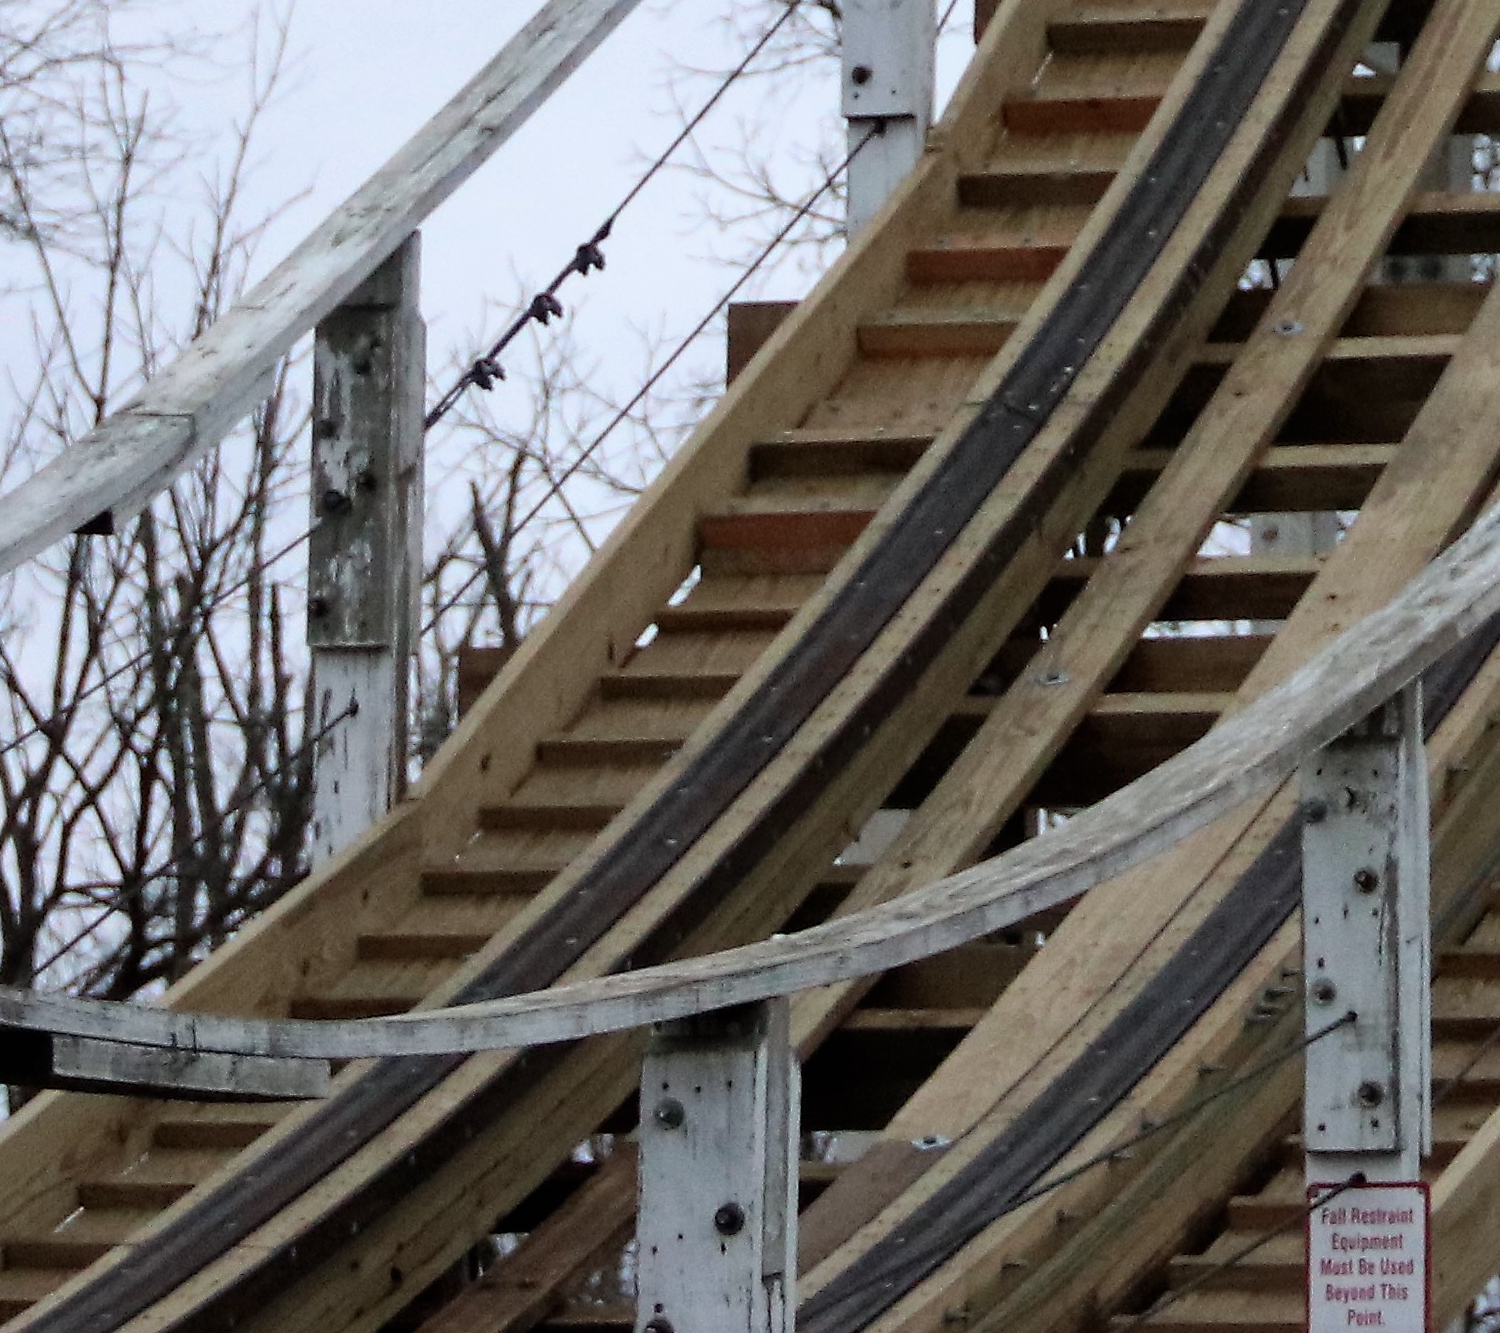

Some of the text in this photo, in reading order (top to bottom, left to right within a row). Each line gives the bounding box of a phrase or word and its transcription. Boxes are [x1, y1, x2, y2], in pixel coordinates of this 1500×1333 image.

[1322, 1207, 1413, 1224] Fall Restraint
[1332, 1233, 1403, 1252] Equipment
[1321, 1258, 1414, 1275] Must Be Used
[1326, 1283, 1408, 1303] Beyond This
